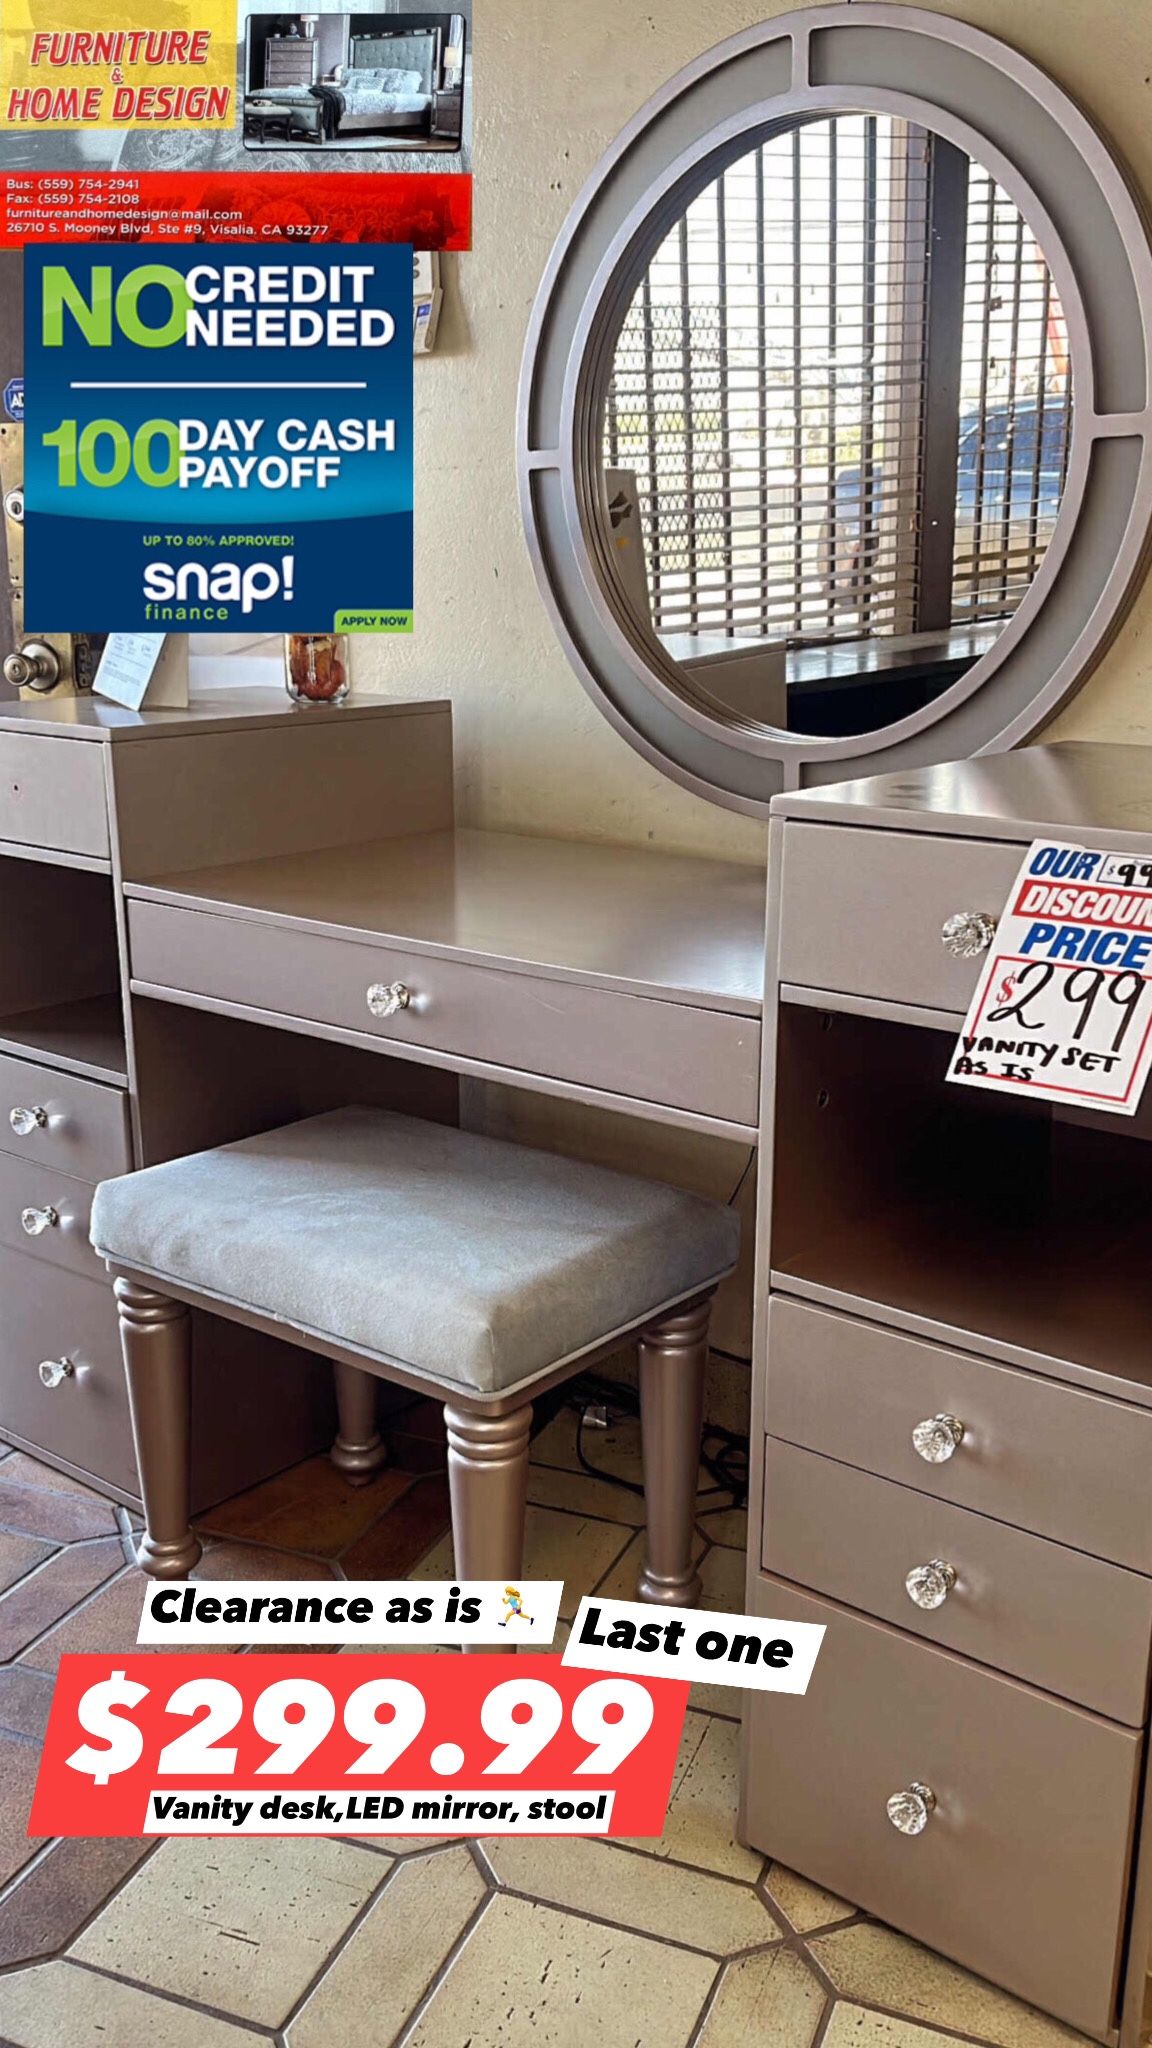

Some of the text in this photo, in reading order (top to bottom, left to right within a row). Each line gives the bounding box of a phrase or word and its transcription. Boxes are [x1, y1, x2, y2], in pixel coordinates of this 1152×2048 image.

[1029, 847, 1101, 881] OUR
[1019, 922, 1152, 970] PRICE
[987, 961, 1146, 1052] $299
[953, 1056, 1035, 1081] AS IS
[962, 1036, 1122, 1073] VANITY SET
